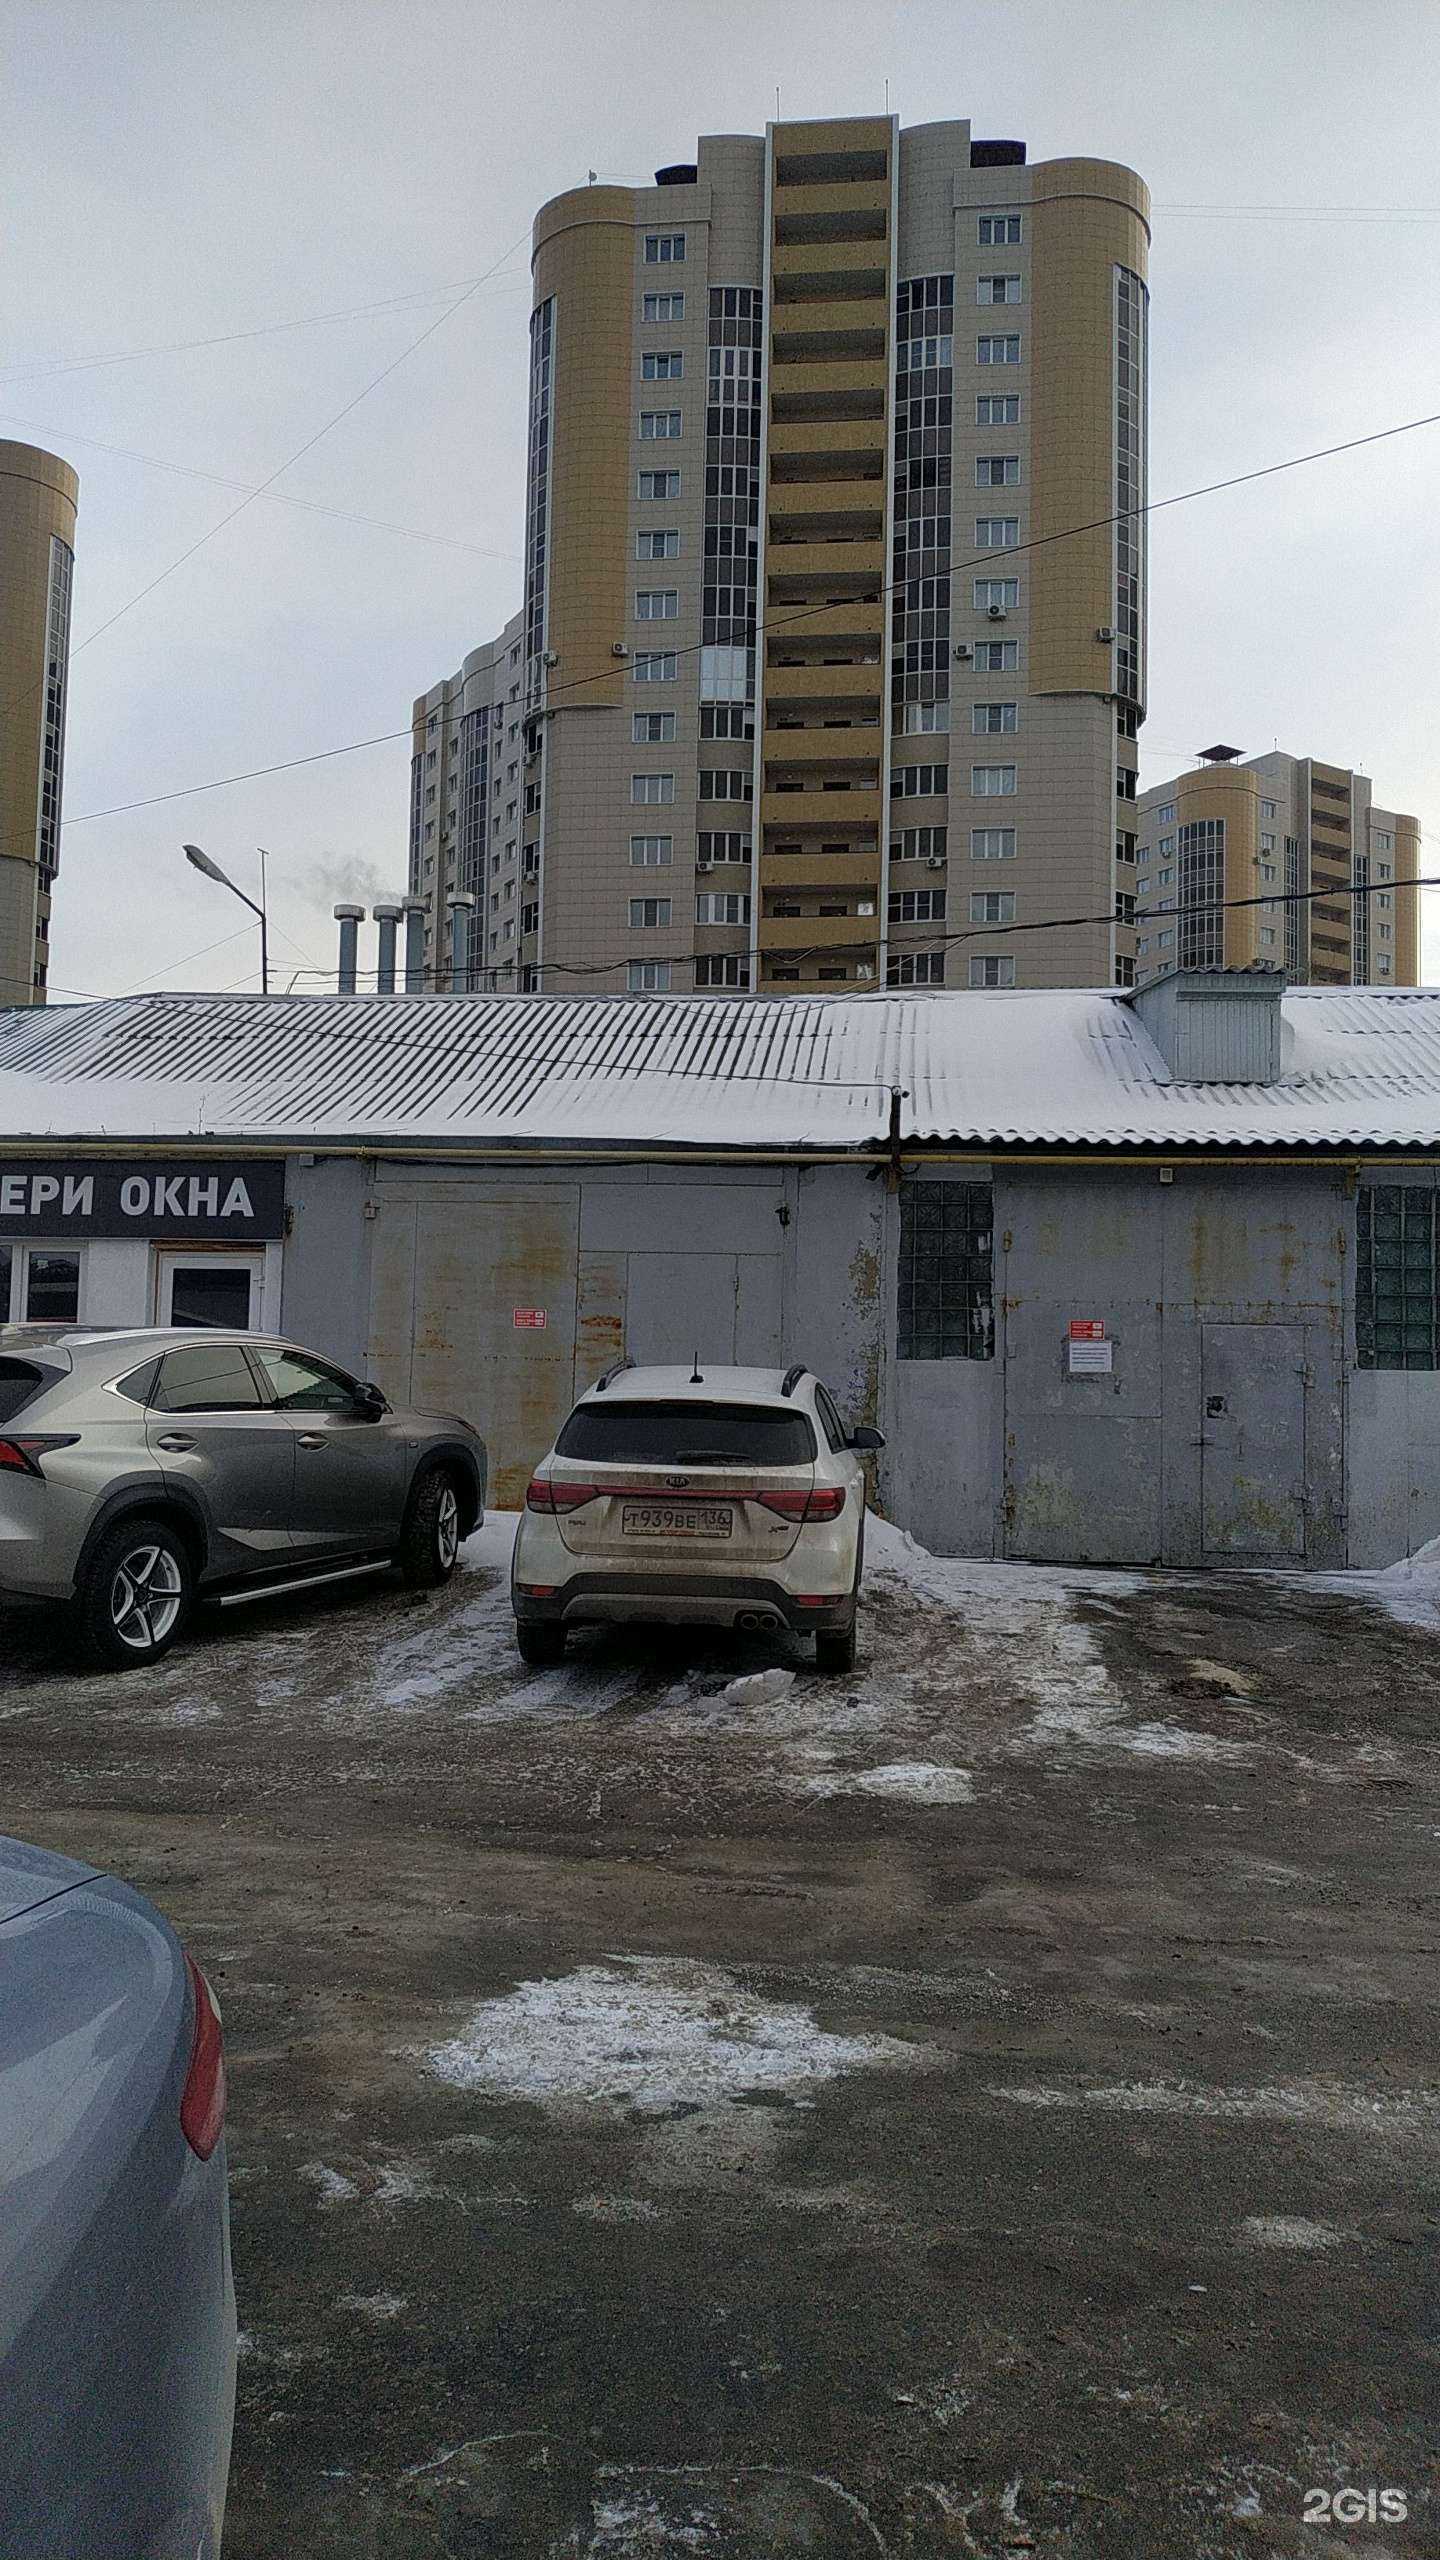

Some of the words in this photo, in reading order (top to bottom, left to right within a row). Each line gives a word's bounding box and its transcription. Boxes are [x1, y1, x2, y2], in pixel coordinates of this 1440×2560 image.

[0, 1175, 94, 1216] ЕРИ
[120, 1176, 255, 1217] ОКНА
[667, 1477, 687, 1487] KIA
